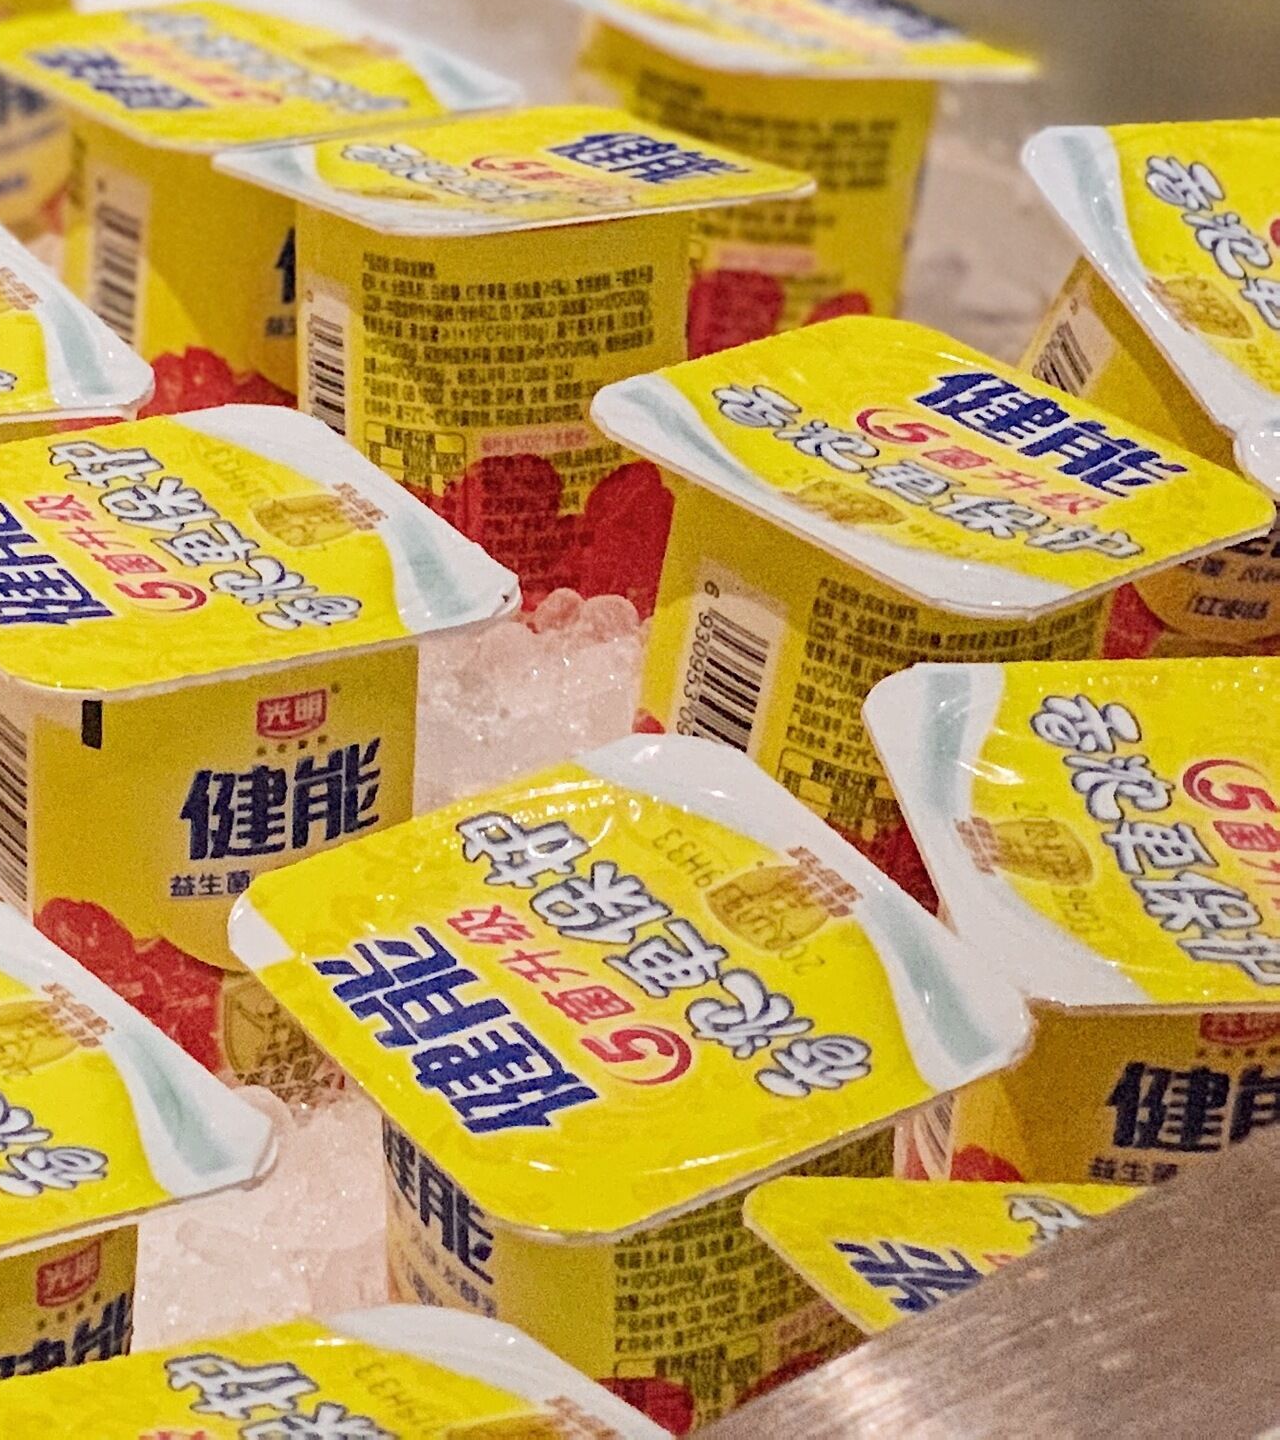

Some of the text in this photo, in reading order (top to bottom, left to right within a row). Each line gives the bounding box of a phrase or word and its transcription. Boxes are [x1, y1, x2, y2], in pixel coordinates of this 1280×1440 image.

[711, 382, 1147, 561] 香浓更保护
[854, 406, 1109, 518] 5菌升级
[914, 370, 1192, 498] 健能
[22, 490, 209, 613] 5菌升级
[47, 438, 364, 630] 香浓更保护
[259, 693, 328, 735] 光明
[178, 737, 382, 863] 健能
[313, 924, 603, 1136] 健能
[447, 904, 695, 1087] 5菌升级
[456, 810, 873, 1098] 香浓更保护
